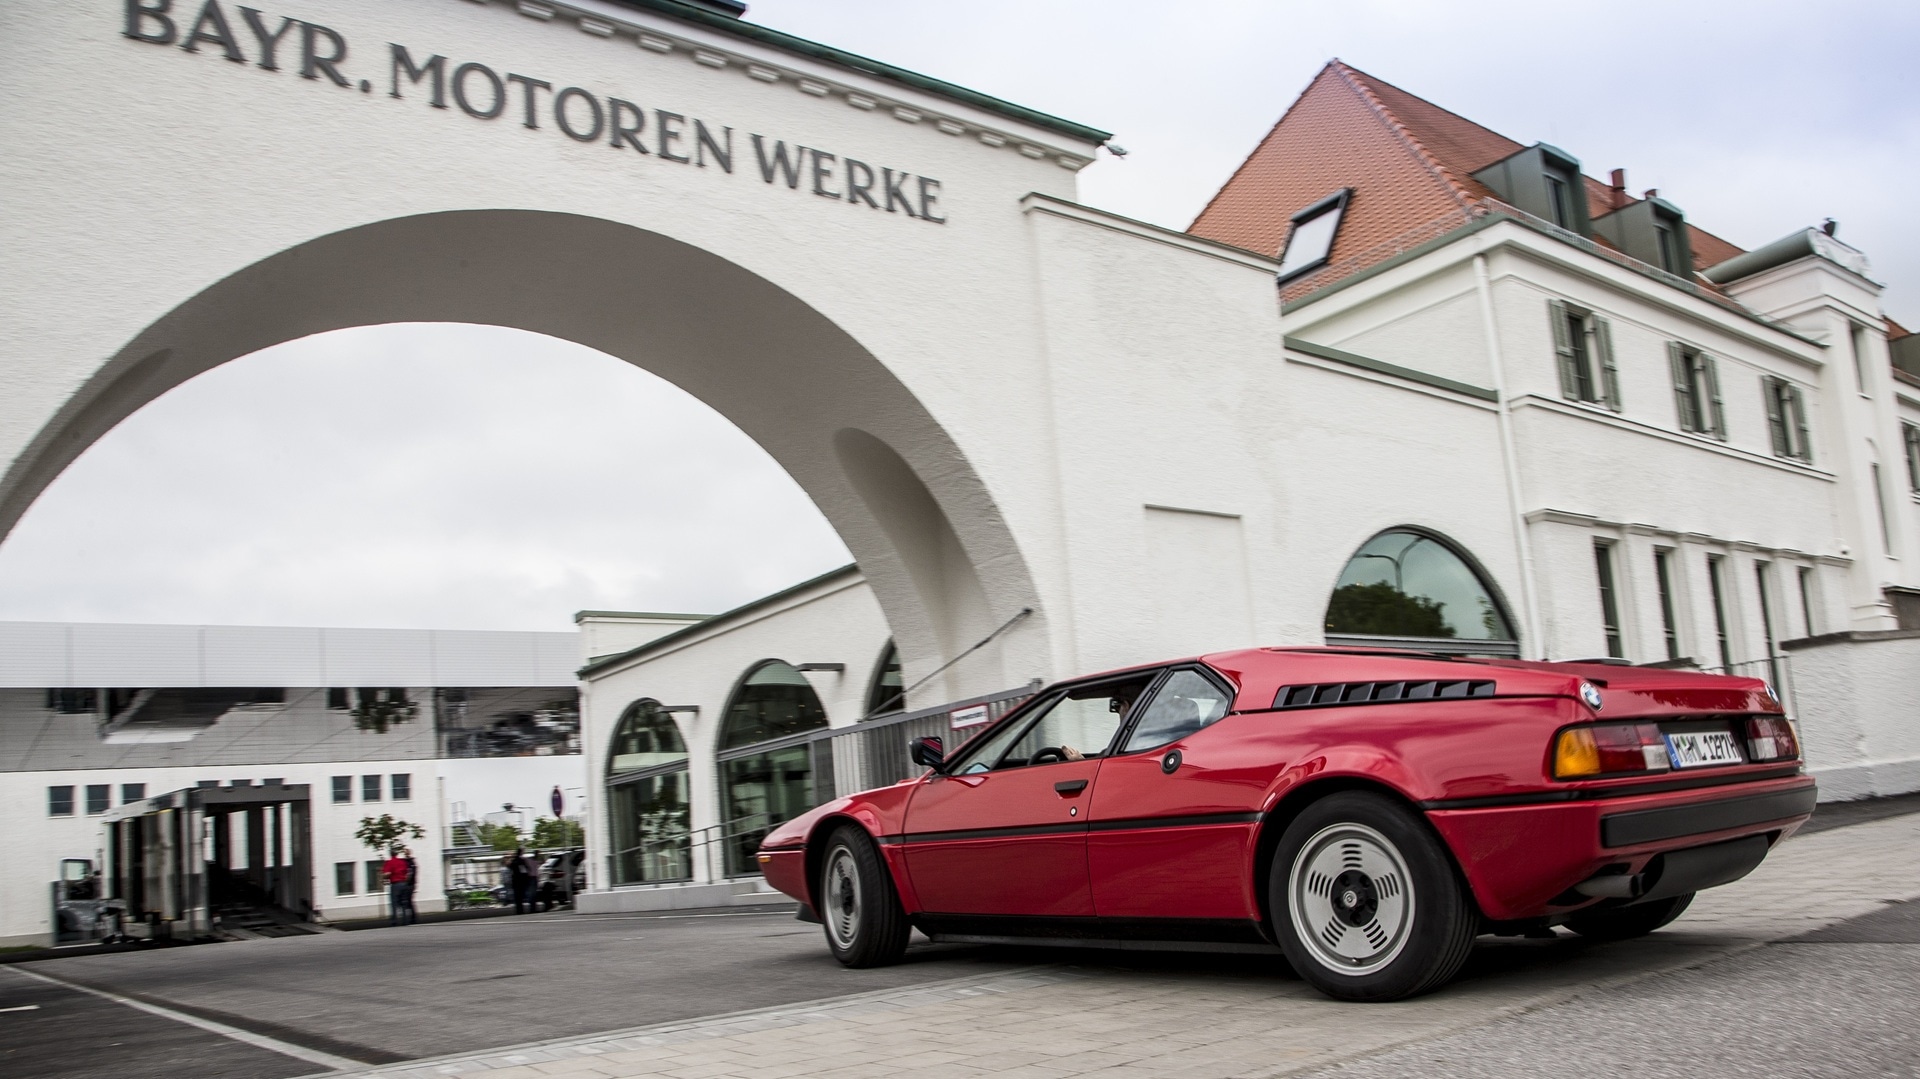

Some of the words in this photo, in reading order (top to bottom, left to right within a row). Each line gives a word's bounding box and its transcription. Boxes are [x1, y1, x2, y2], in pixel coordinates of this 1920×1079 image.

[122, 0, 371, 94] BAYR.
[389, 42, 734, 174] MOTOREN
[749, 133, 946, 225] WERKE
